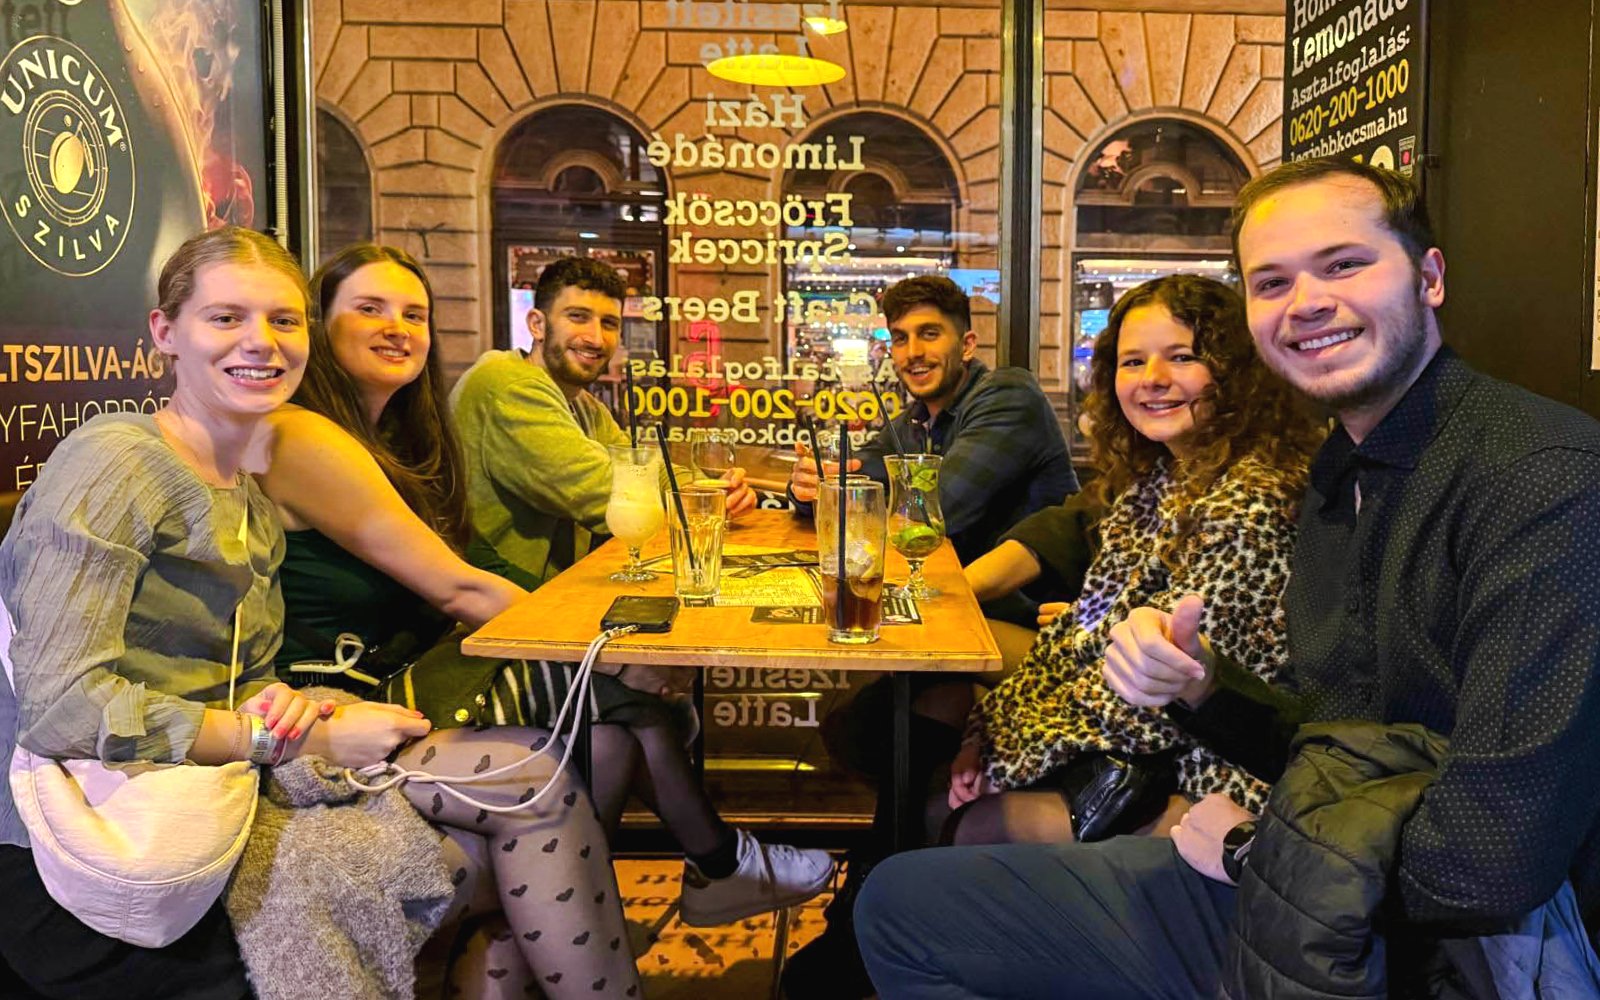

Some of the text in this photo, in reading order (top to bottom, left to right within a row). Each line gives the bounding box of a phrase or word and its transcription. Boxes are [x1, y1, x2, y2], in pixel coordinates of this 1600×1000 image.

[0, 49, 124, 147] UNICUM
[1290, 59, 1409, 146] 0620-200-1000
[1291, 24, 1410, 110] Asztalfoglalás:
[15, 195, 120, 260] SZILVA
